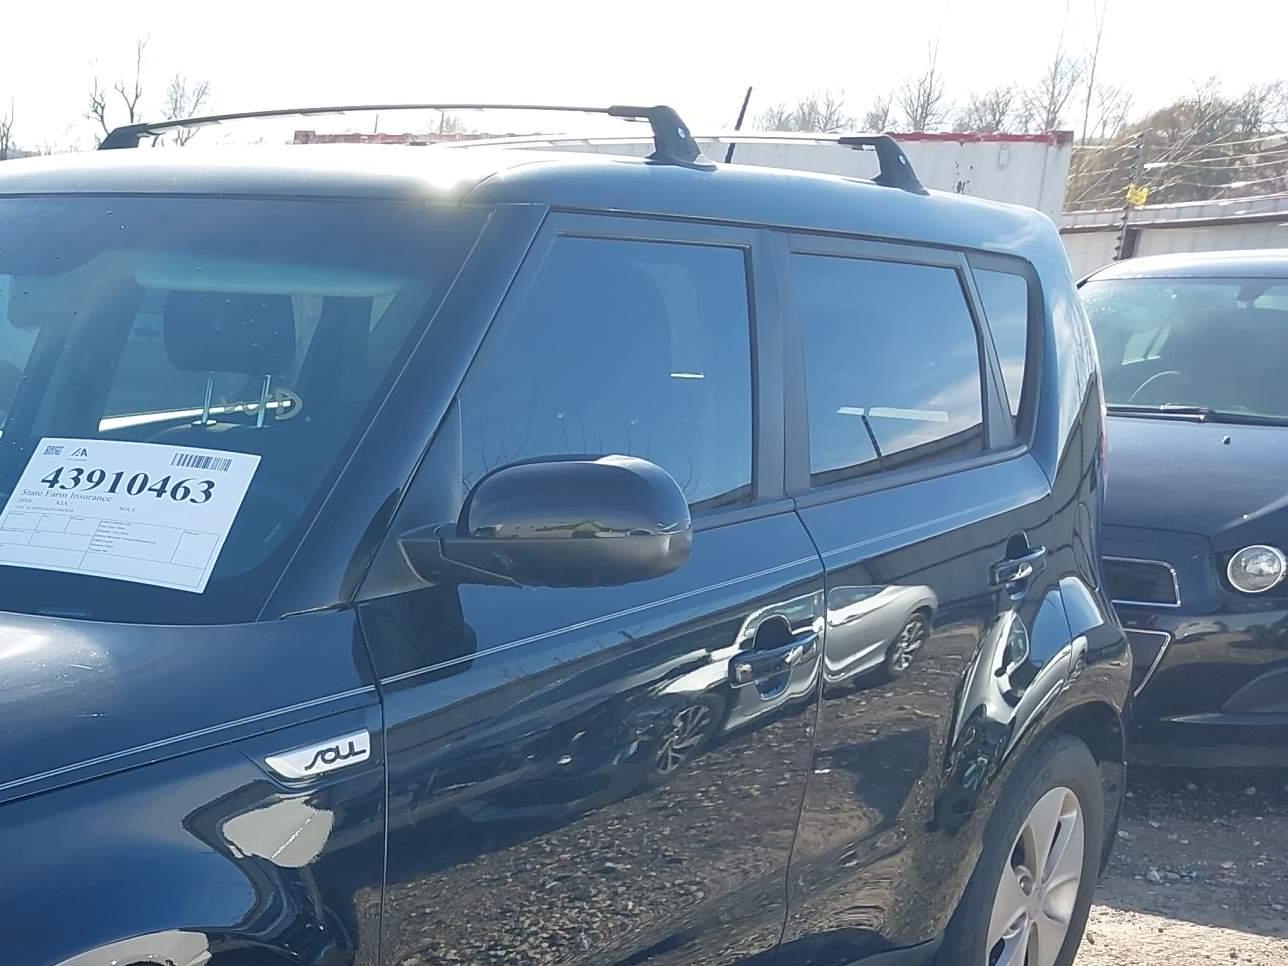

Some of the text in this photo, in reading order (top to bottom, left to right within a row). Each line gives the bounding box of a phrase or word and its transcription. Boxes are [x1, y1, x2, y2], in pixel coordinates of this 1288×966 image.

[21, 488, 113, 503] State Farm Insurance
[41, 466, 216, 504] 43910463
[304, 741, 367, 771] SOUL
